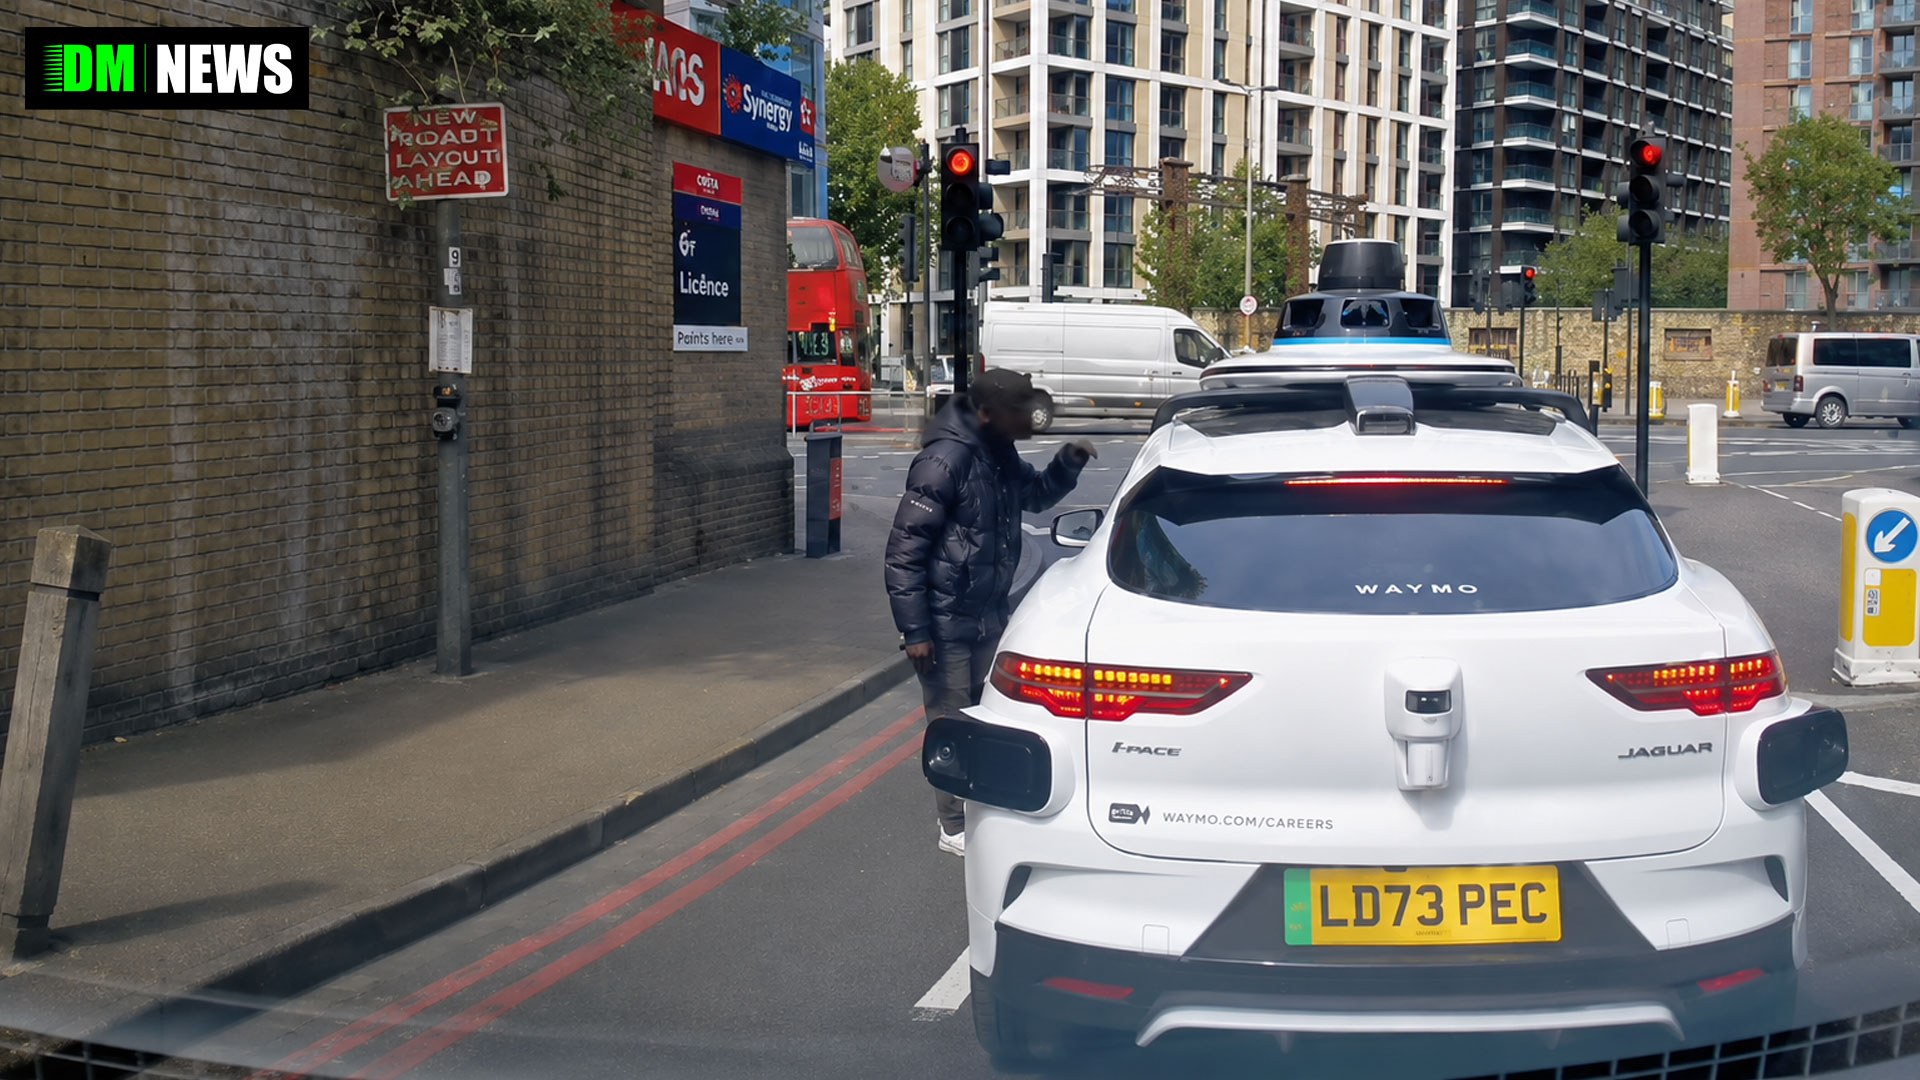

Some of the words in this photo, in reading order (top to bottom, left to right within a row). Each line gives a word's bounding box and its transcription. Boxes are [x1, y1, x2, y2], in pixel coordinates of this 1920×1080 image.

[743, 84, 793, 132] Synergy
[412, 110, 477, 126] NEW
[392, 170, 491, 190] AHEAD
[711, 331, 734, 346] here
[1354, 583, 1478, 595] WAYMO
[1617, 742, 1713, 759] JAGUAR
[1162, 812, 1334, 830] WAYMO.COM/CAREERS
[1319, 884, 1445, 928] LD73
[1457, 881, 1549, 926] PEC
